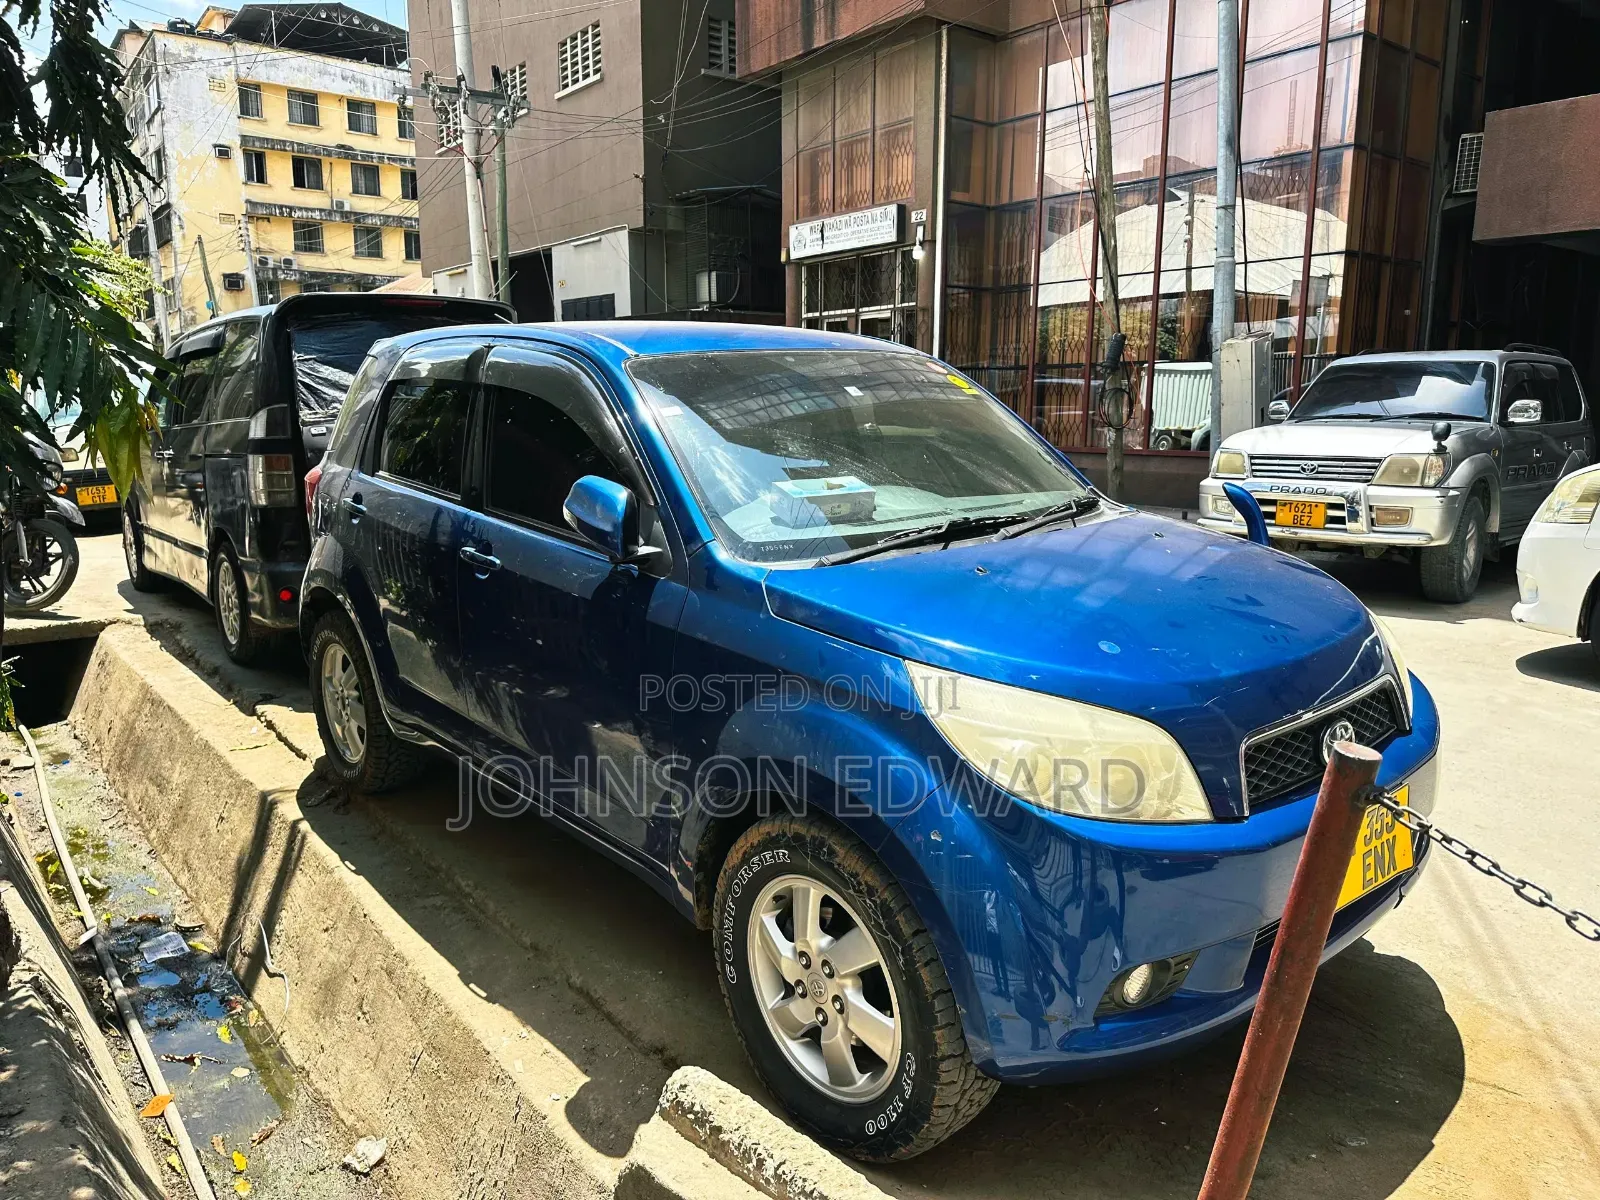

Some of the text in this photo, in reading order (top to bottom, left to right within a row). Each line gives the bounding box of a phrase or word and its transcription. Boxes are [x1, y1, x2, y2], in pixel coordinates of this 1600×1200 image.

[853, 214, 869, 228] POSTA
[871, 212, 878, 225] NA
[880, 209, 893, 223] SIMU
[914, 211, 924, 221] 22
[1506, 461, 1557, 480] PRADO
[1269, 485, 1327, 496] PRADO
[1287, 502, 1313, 515] T621
[1292, 514, 1313, 527] BEZ
[1362, 834, 1398, 891] ENX
[723, 849, 792, 985] COMFORSER
